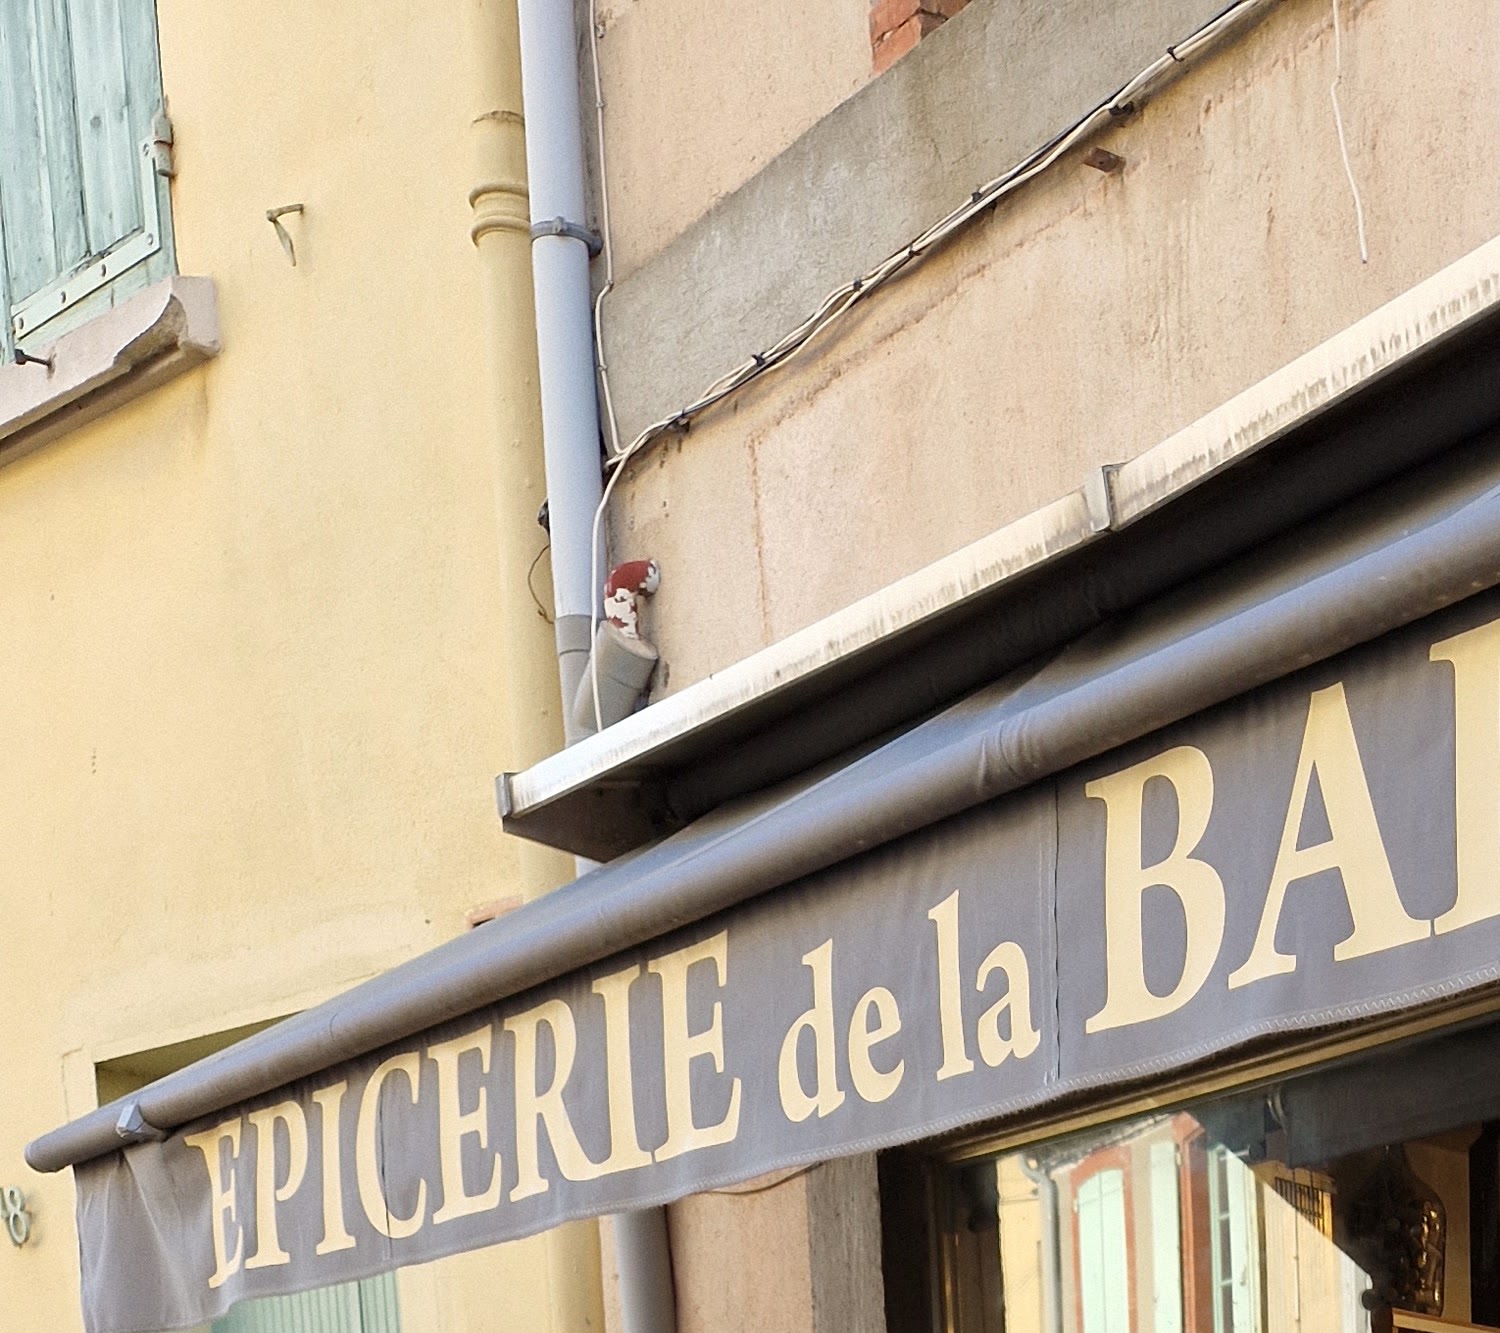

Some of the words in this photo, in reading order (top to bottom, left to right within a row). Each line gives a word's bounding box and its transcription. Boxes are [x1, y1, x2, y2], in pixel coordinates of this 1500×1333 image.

[183, 927, 743, 1290] EPICERIE
[778, 938, 906, 1123] de
[927, 889, 1042, 1082] la
